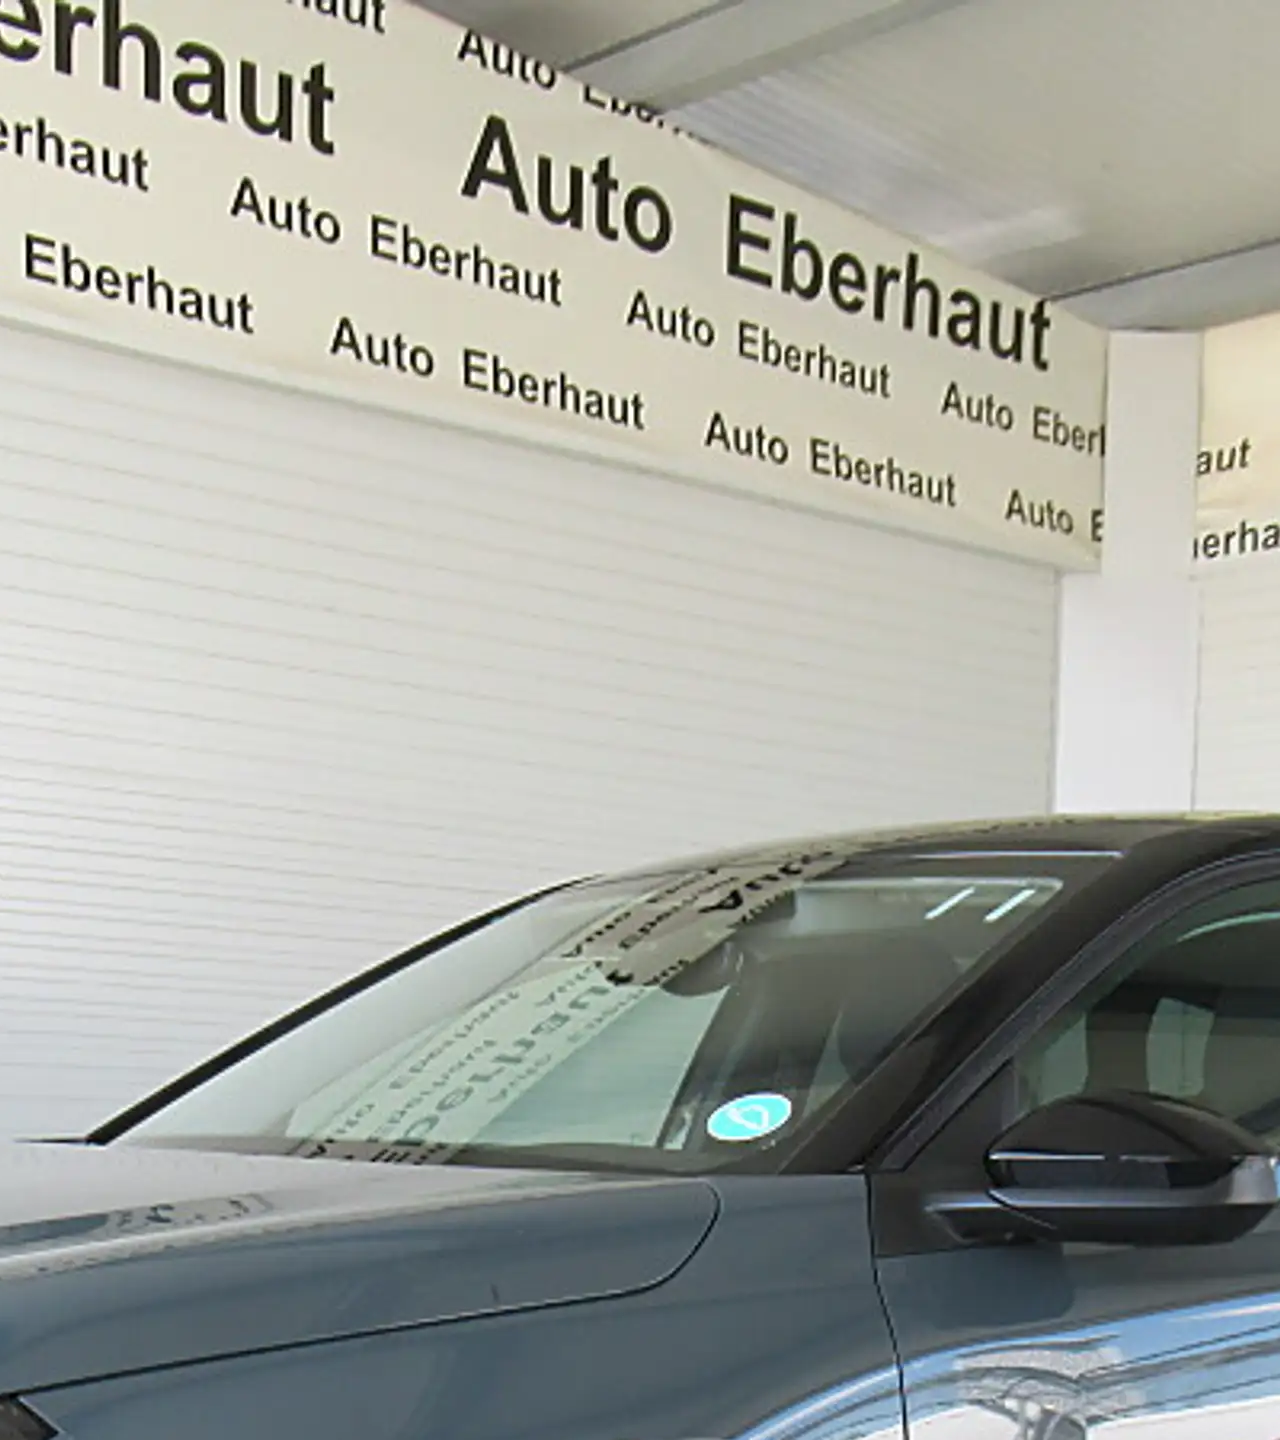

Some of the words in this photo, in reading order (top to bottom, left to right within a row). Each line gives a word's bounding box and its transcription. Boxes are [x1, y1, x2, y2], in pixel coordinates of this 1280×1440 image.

[25, 234, 254, 334] Eberhaut
[231, 178, 341, 244] Auto
[371, 215, 562, 307] Eberhaut
[461, 115, 672, 253] Auto
[726, 194, 1052, 372] Eberhaut
[330, 317, 434, 377] Auto
[463, 349, 644, 430] Eberhaut
[626, 291, 715, 348] Auto
[739, 321, 890, 399] Eberhaut
[941, 382, 1014, 431] Auto
[705, 413, 789, 465] Auto
[810, 439, 956, 508] Eberhaut
[1005, 490, 1074, 535] Auto
